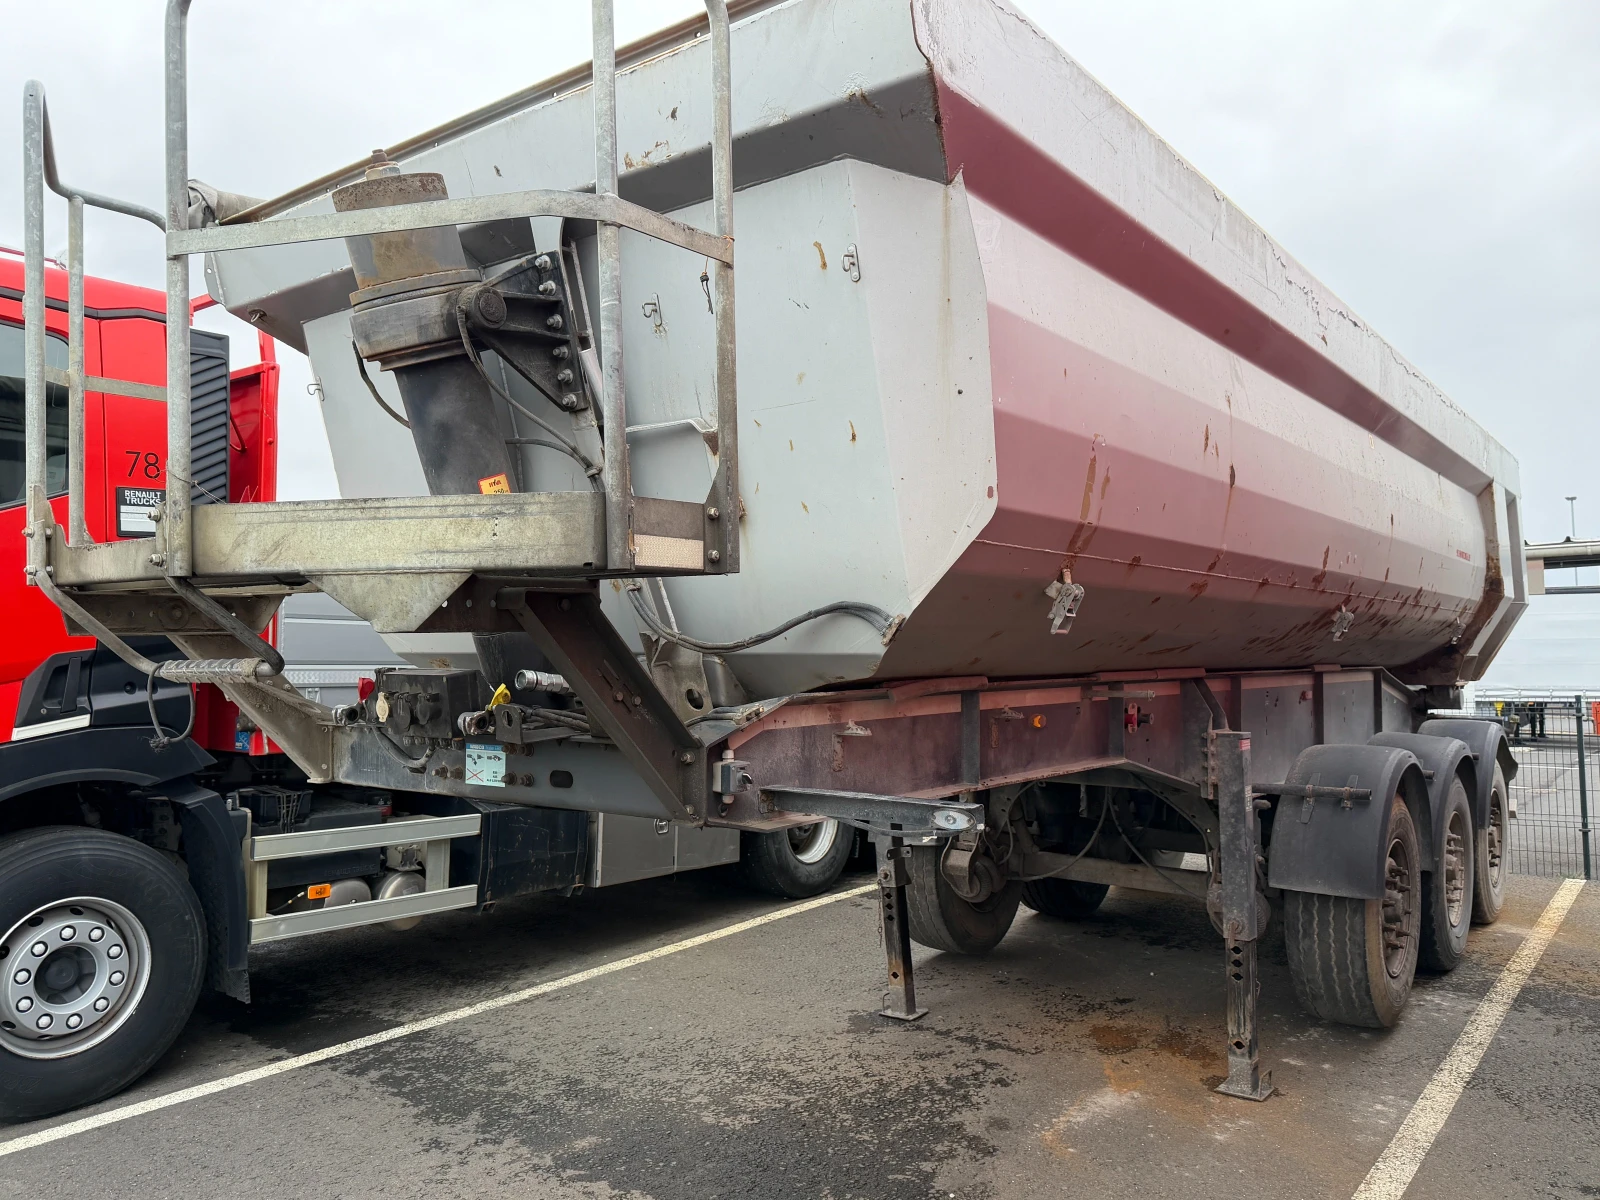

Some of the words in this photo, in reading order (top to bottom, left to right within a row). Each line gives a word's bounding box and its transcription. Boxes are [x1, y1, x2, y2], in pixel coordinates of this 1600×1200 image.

[126, 450, 160, 479] 78
[124, 490, 162, 499] RENAULT
[125, 496, 162, 505] TRUCKS
